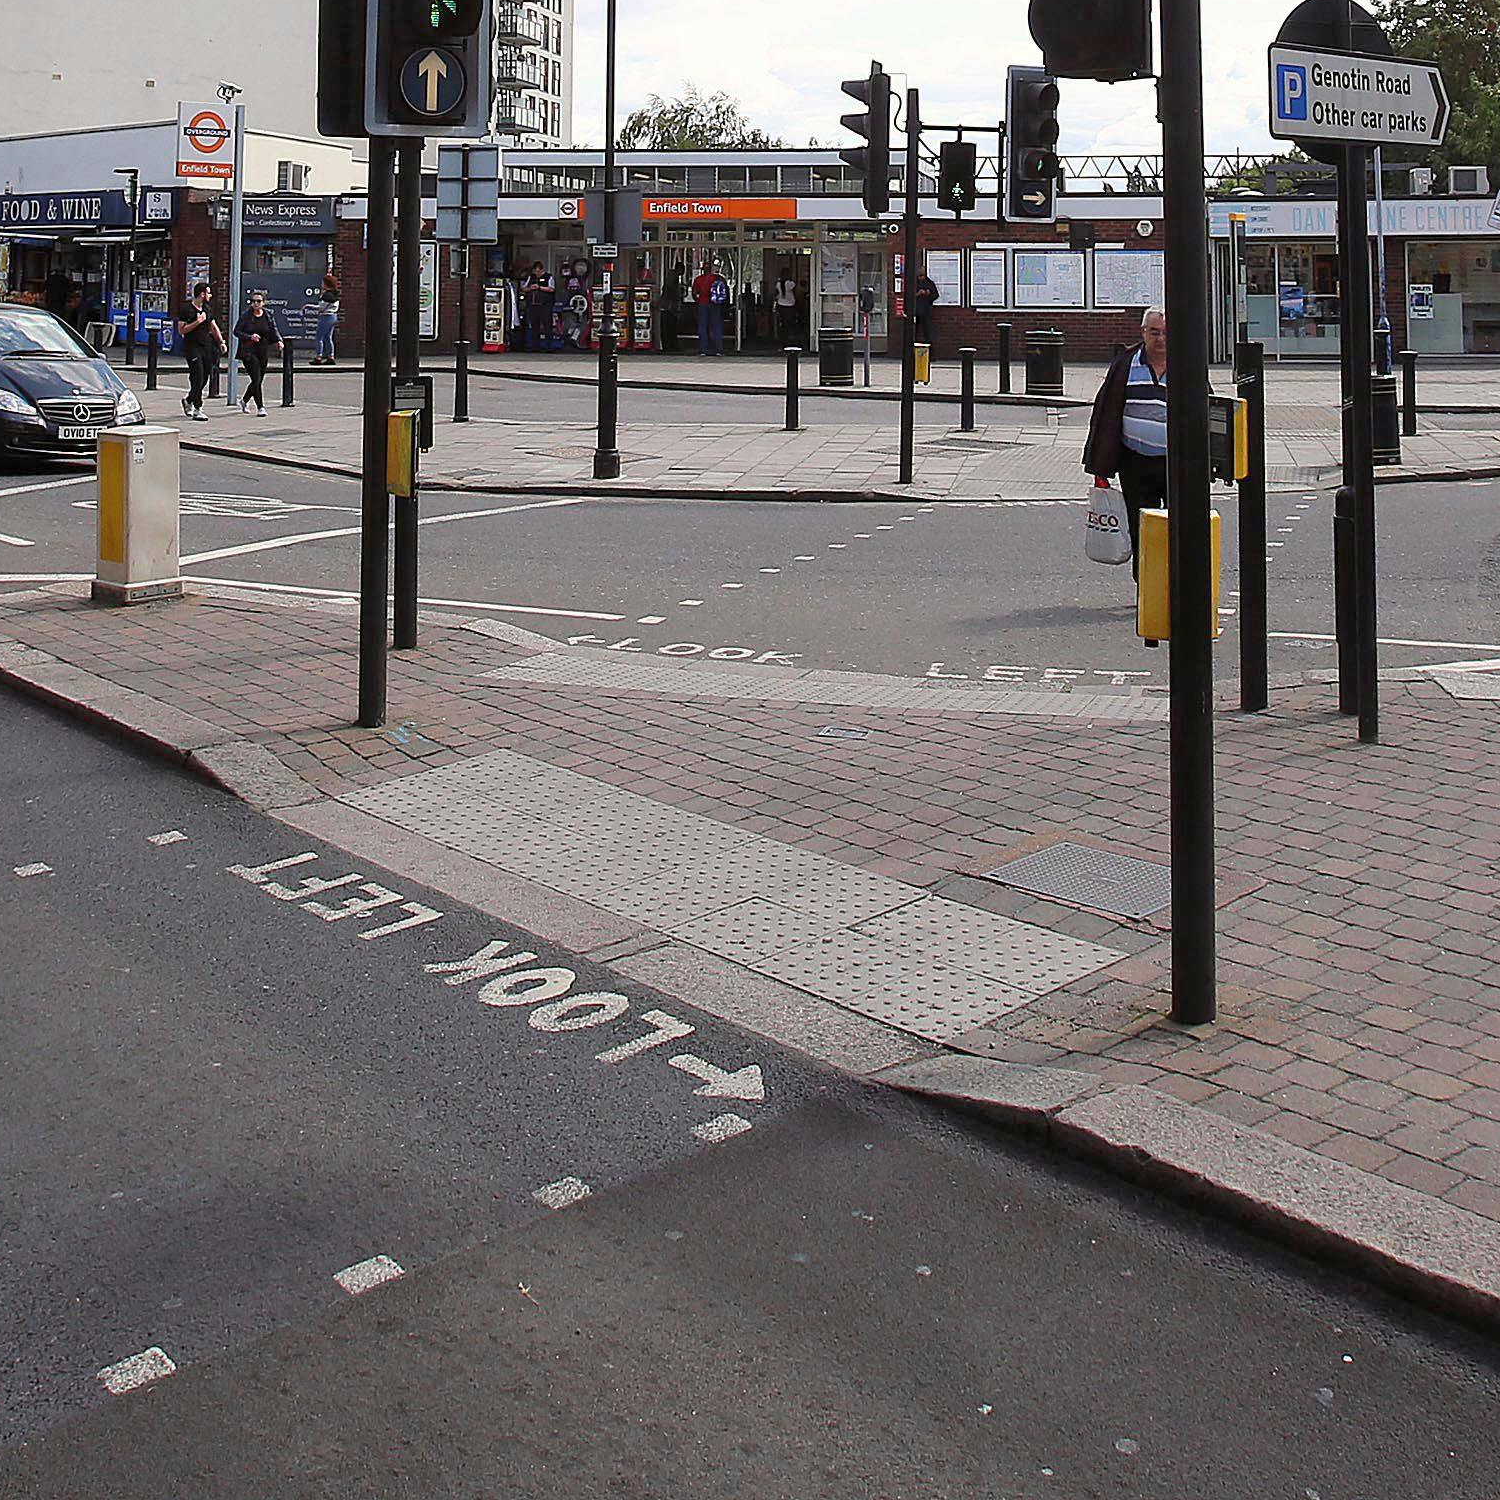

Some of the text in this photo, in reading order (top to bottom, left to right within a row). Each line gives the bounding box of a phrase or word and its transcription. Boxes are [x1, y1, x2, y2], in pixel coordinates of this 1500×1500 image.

[1311, 62, 1411, 95] Genotin Road
[1283, 70, 1303, 114] P
[1312, 100, 1427, 134] Other car parks
[186, 128, 229, 137] OVERGROUND
[181, 164, 231, 175] Enfield Town
[2, 199, 40, 223] FOOD
[46, 199, 58, 221] &
[61, 197, 101, 221] WINE
[245, 204, 274, 216] News
[278, 204, 317, 218] Express
[649, 201, 722, 214] Enfield Town
[1415, 205, 1484, 231] CENTRE
[86, 427, 102, 438] ET
[604, 635, 1152, 687] LOOK LEFT
[225, 851, 697, 1065] LOOK LEFT
